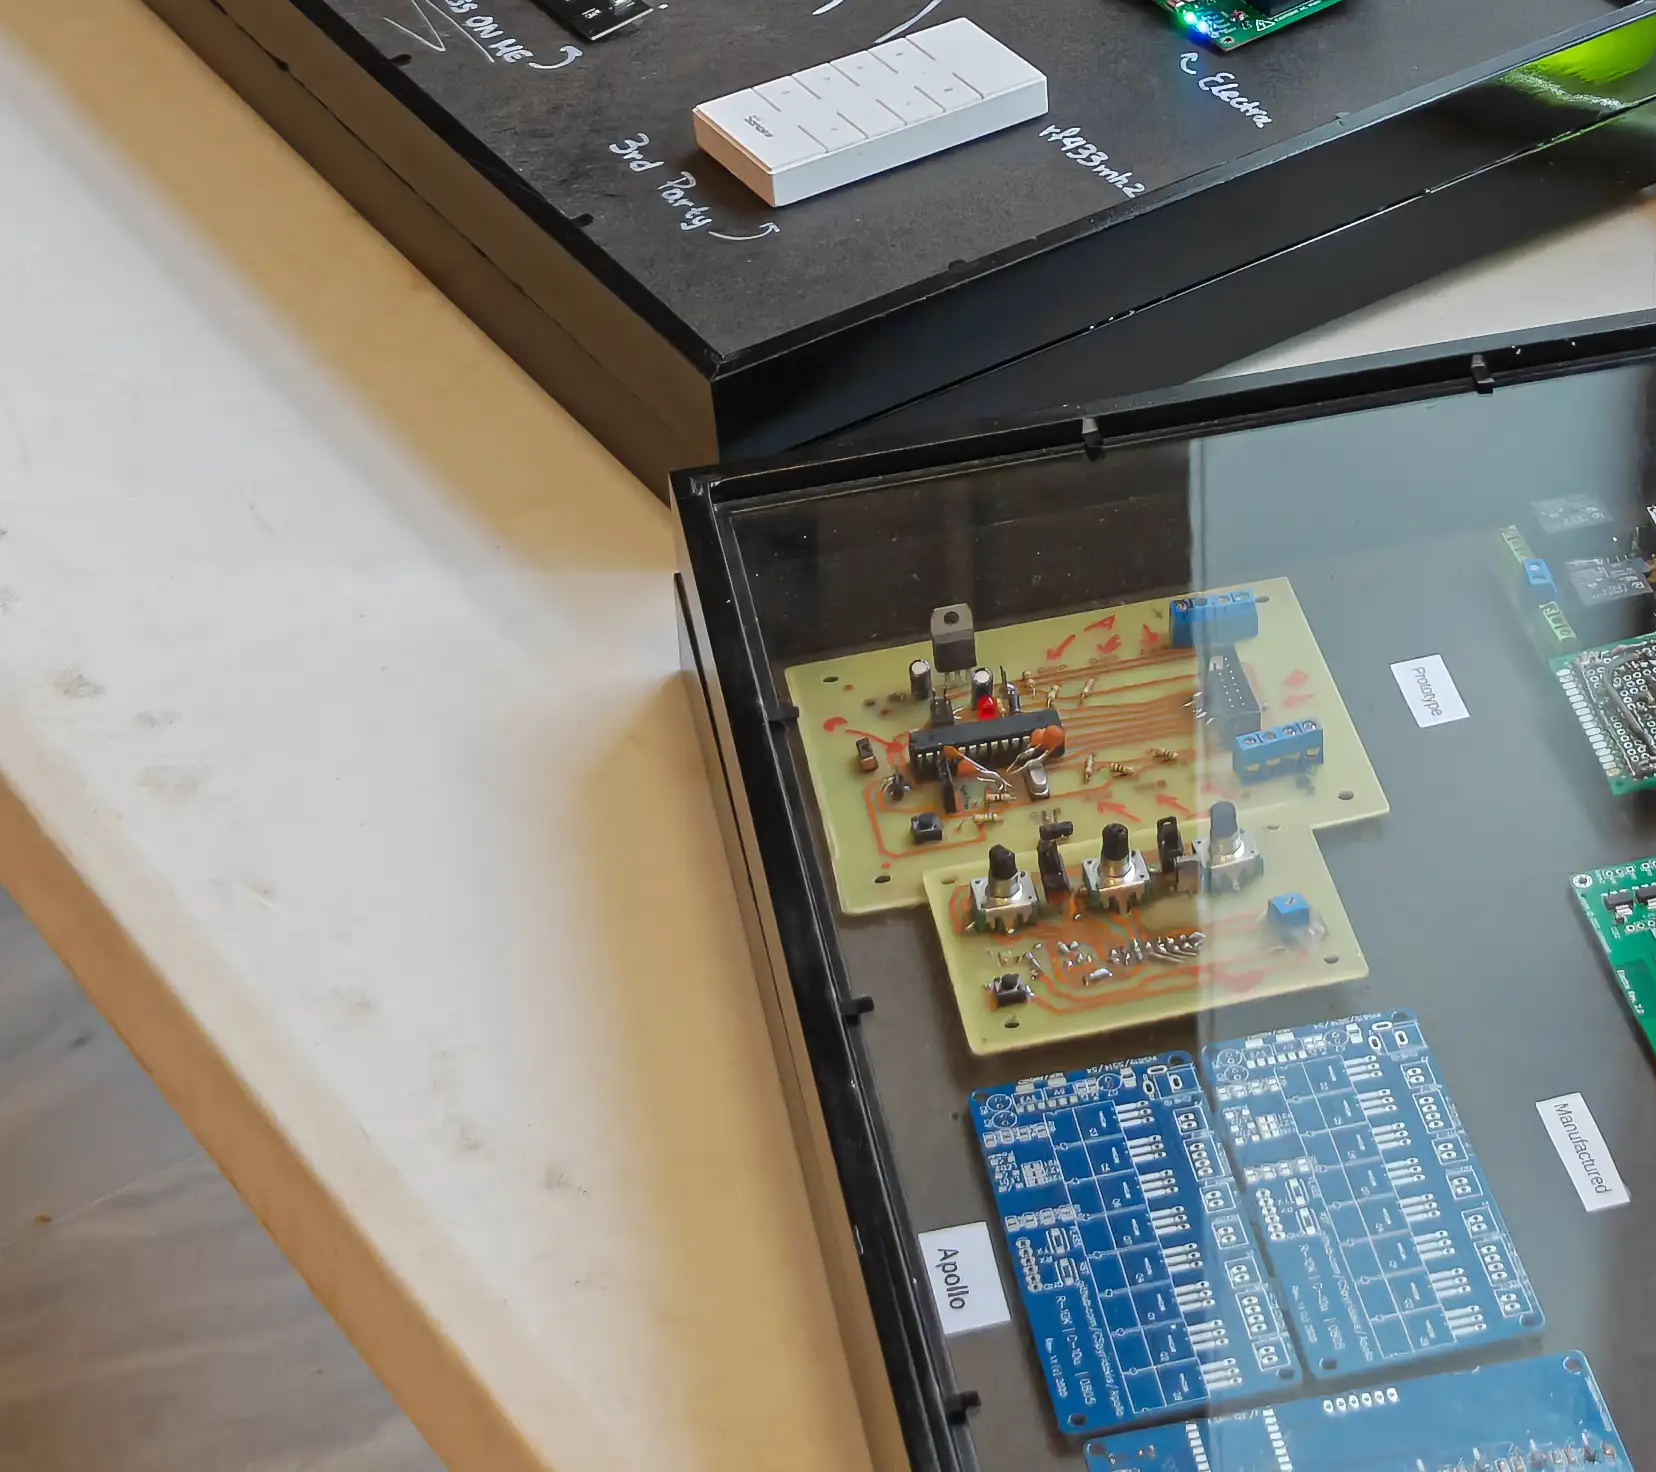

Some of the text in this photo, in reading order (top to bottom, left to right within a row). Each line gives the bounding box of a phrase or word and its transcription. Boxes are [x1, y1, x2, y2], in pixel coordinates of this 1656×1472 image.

[464, 15, 504, 40] ON
[488, 38, 534, 64] ME
[1198, 72, 1273, 129] Electra
[608, 132, 713, 231] 3rd Party
[1411, 666, 1444, 717] Prototype
[1552, 1102, 1613, 1195] Manufactured
[936, 1247, 970, 1311] Apollo
